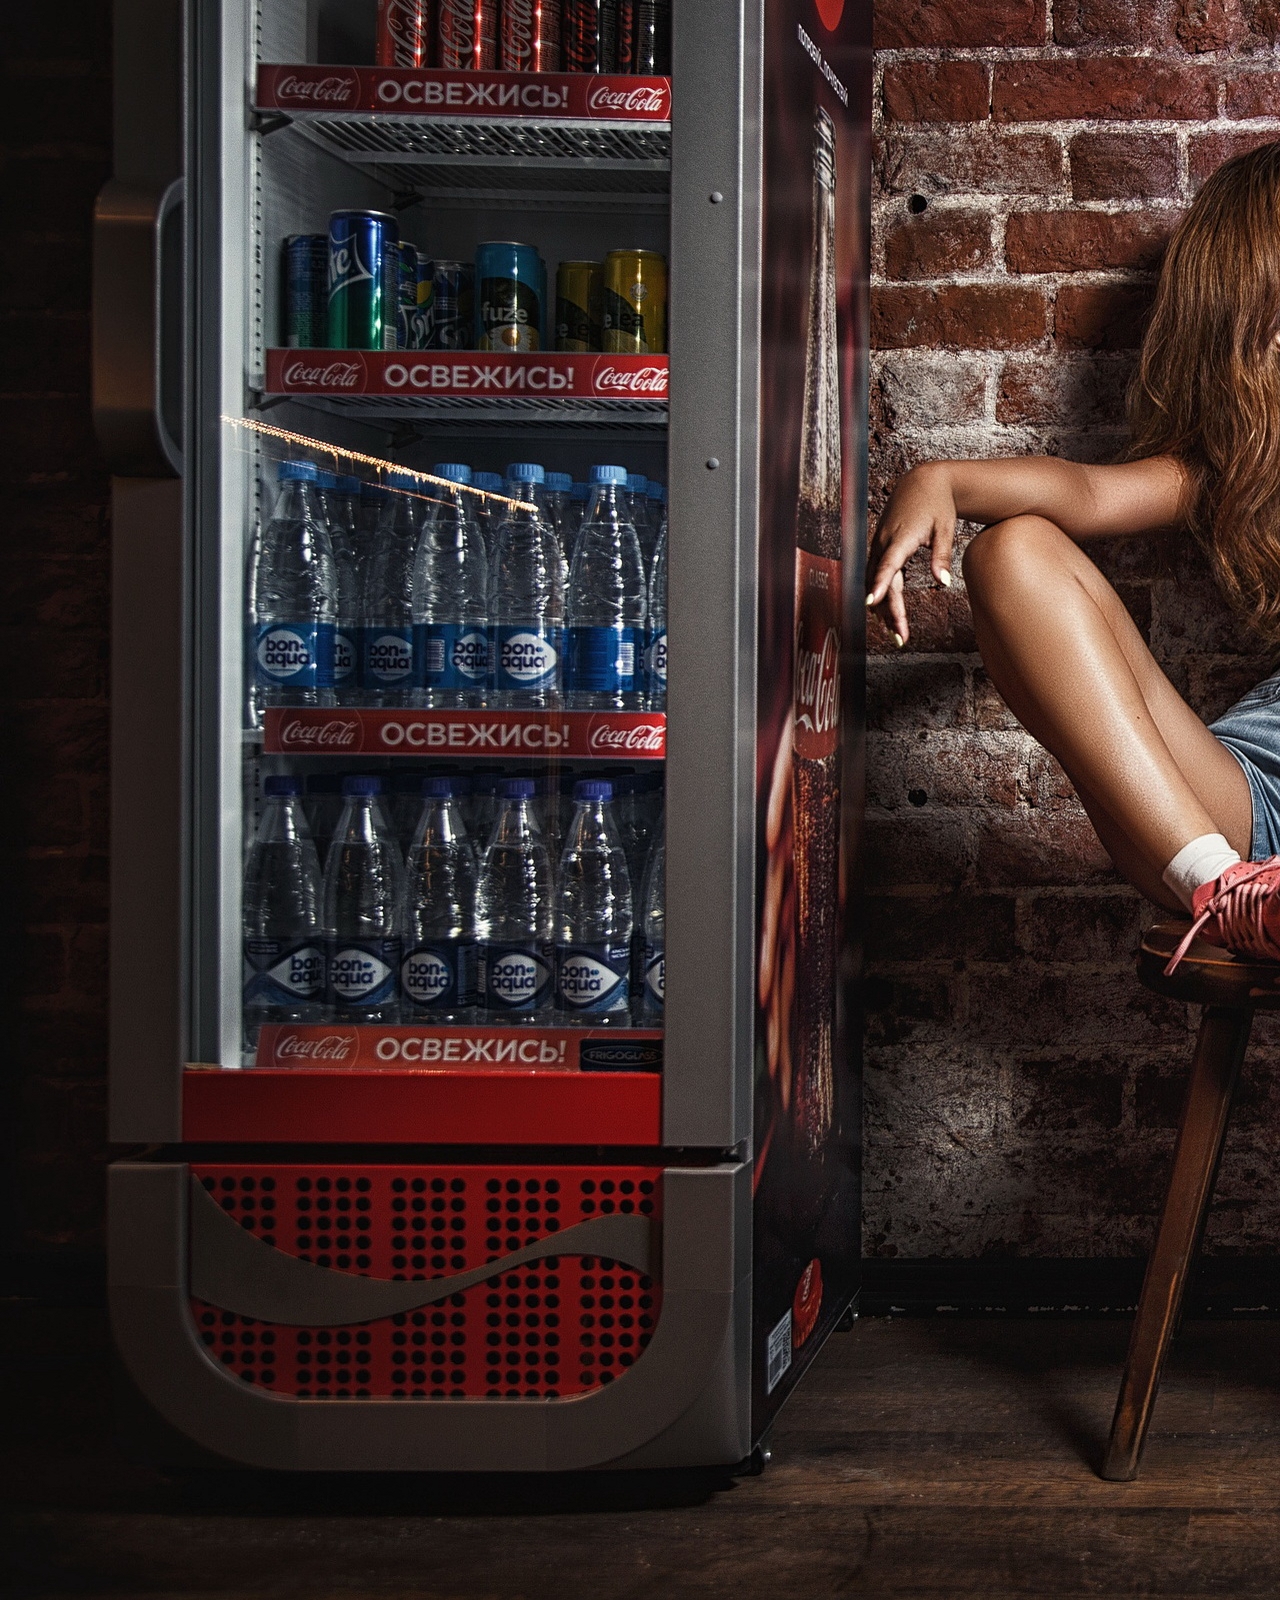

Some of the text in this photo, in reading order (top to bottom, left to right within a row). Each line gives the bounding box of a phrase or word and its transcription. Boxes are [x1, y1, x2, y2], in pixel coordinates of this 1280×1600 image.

[277, 76, 355, 101] Coca-Cola
[378, 79, 568, 108] ОСВЕЖИСЬ!
[590, 86, 666, 112] Coca-Cola
[482, 301, 529, 323] fuze
[285, 361, 362, 387] Coca-Cola
[384, 363, 574, 390] ОСВЕЖИСЬ!
[595, 366, 669, 392] Coca-Cola
[265, 653, 310, 668] aqua
[501, 656, 545, 671] aqua
[282, 719, 359, 745] Coca-Cola
[381, 721, 569, 748] ОСВЕЖИСЬ!
[591, 724, 667, 750] Coca-Cola
[408, 974, 450, 990] aqua
[491, 976, 536, 992] aqua
[277, 1034, 356, 1060] Coca-Cola
[376, 1036, 566, 1063] ОСВЕЖИСЬ!
[589, 1050, 657, 1061] FRIGOGLASS
